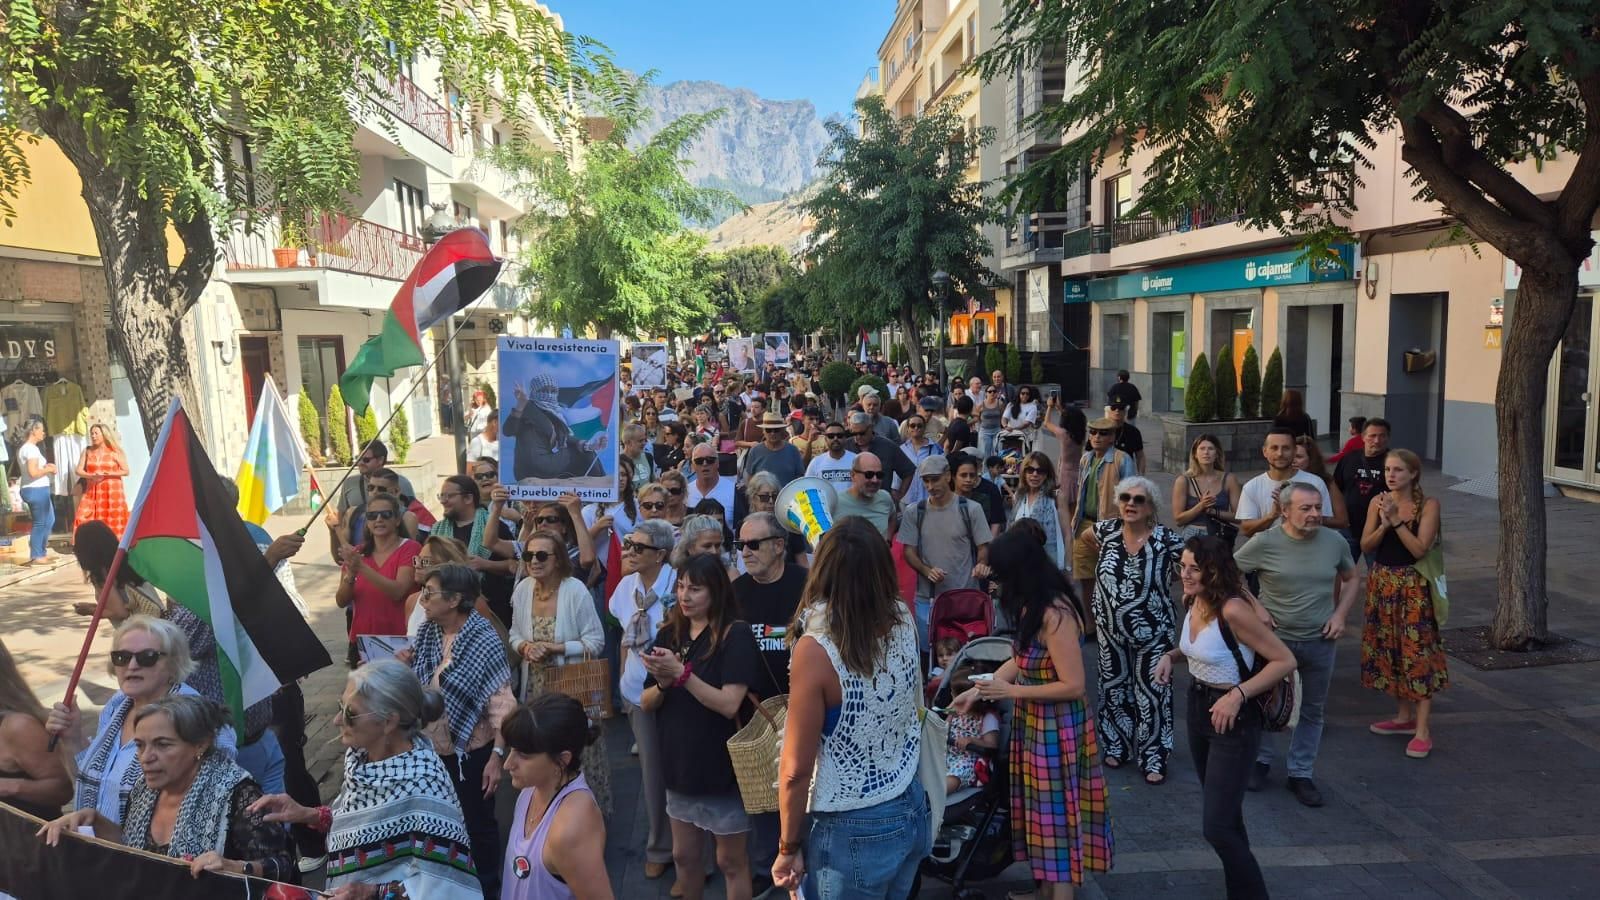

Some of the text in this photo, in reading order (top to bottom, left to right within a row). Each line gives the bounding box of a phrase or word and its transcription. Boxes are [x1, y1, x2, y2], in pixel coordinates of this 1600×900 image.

[1257, 261, 1294, 281] cajamar
[1150, 275, 1174, 292] cajamar
[0, 340, 55, 358] DYS
[507, 340, 607, 353] Viva la resistencia
[522, 487, 558, 498] pueblo
[560, 488, 611, 499] plestino!
